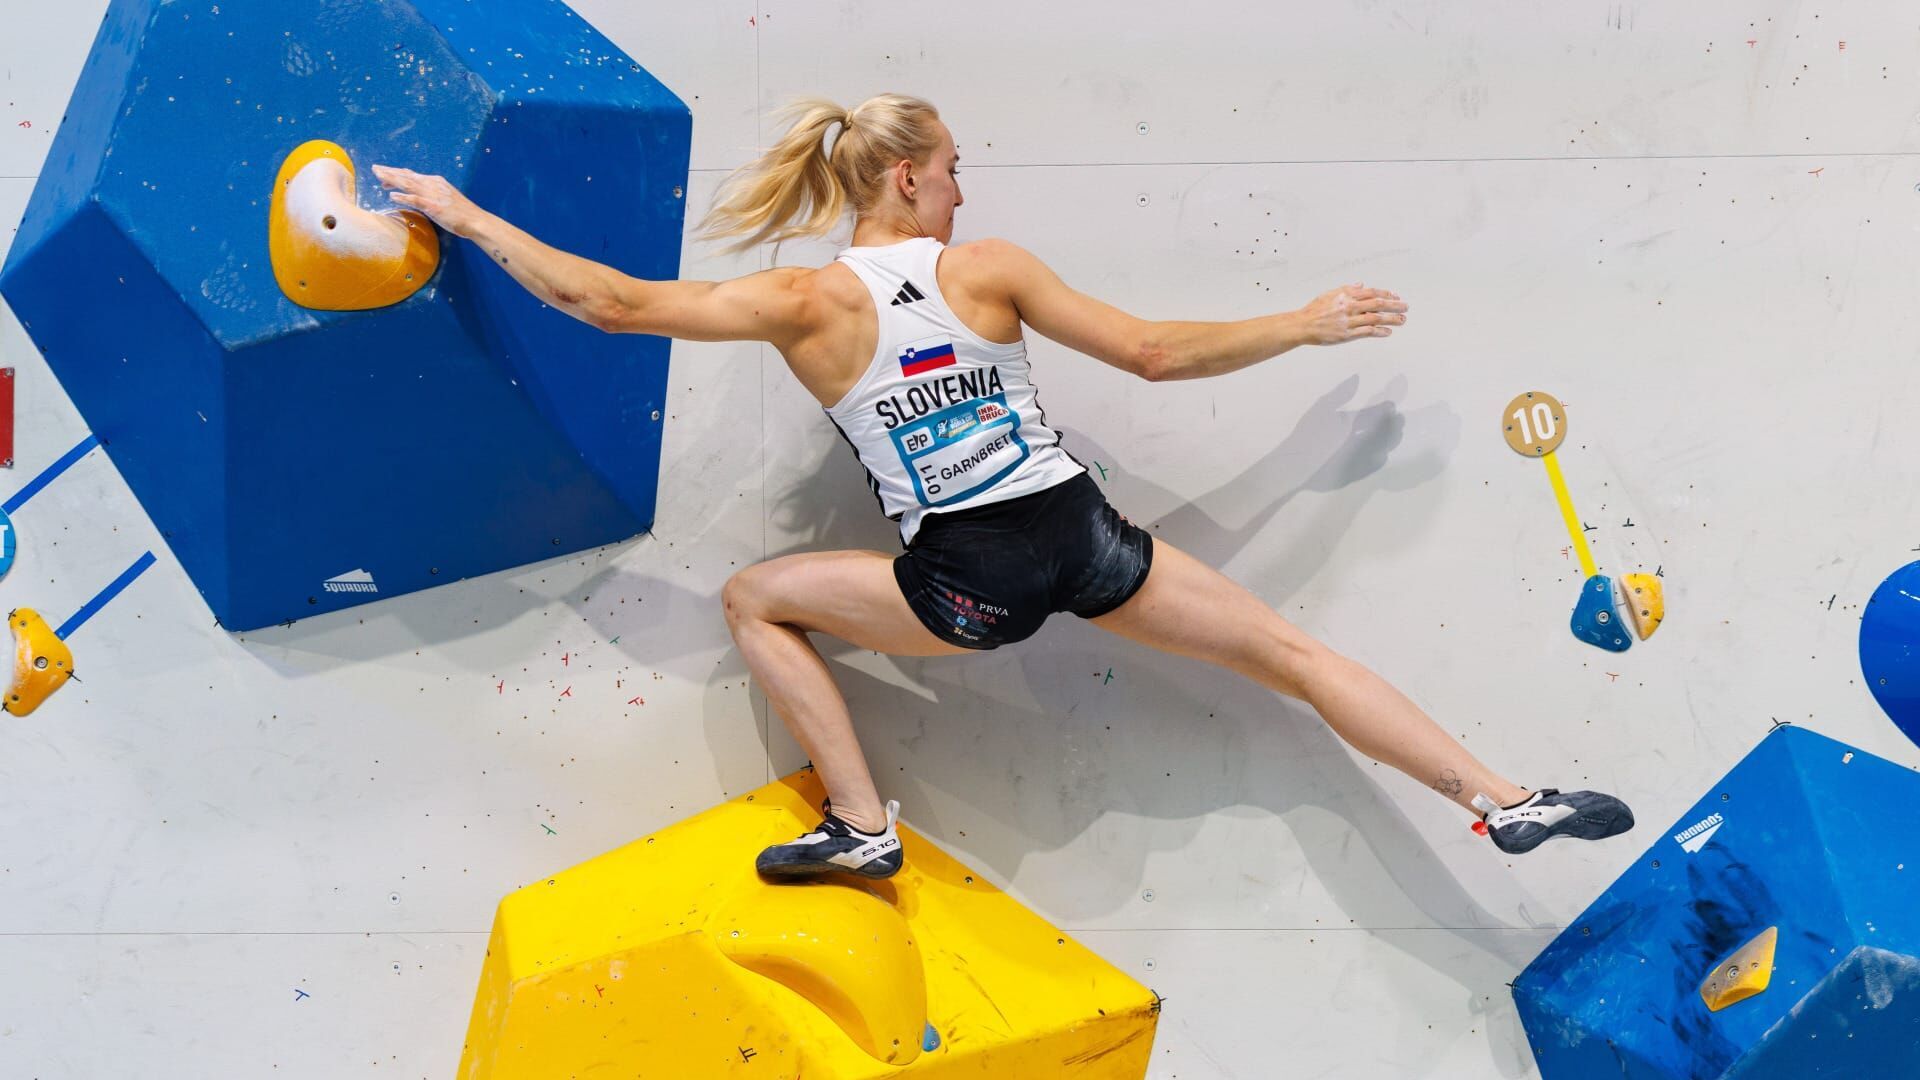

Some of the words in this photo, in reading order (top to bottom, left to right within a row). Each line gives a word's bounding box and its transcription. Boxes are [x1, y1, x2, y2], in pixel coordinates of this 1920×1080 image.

[875, 365, 1004, 429] SLOVENIA
[1513, 403, 1556, 444] 10
[940, 433, 1010, 480] GARNBRET
[920, 464, 941, 495] 011
[322, 582, 378, 593] SQUADRA
[953, 605, 997, 624] TOYOTA
[979, 603, 1009, 616] PRVA
[1674, 812, 1723, 844] SQUADRA
[861, 838, 897, 858] 5.10
